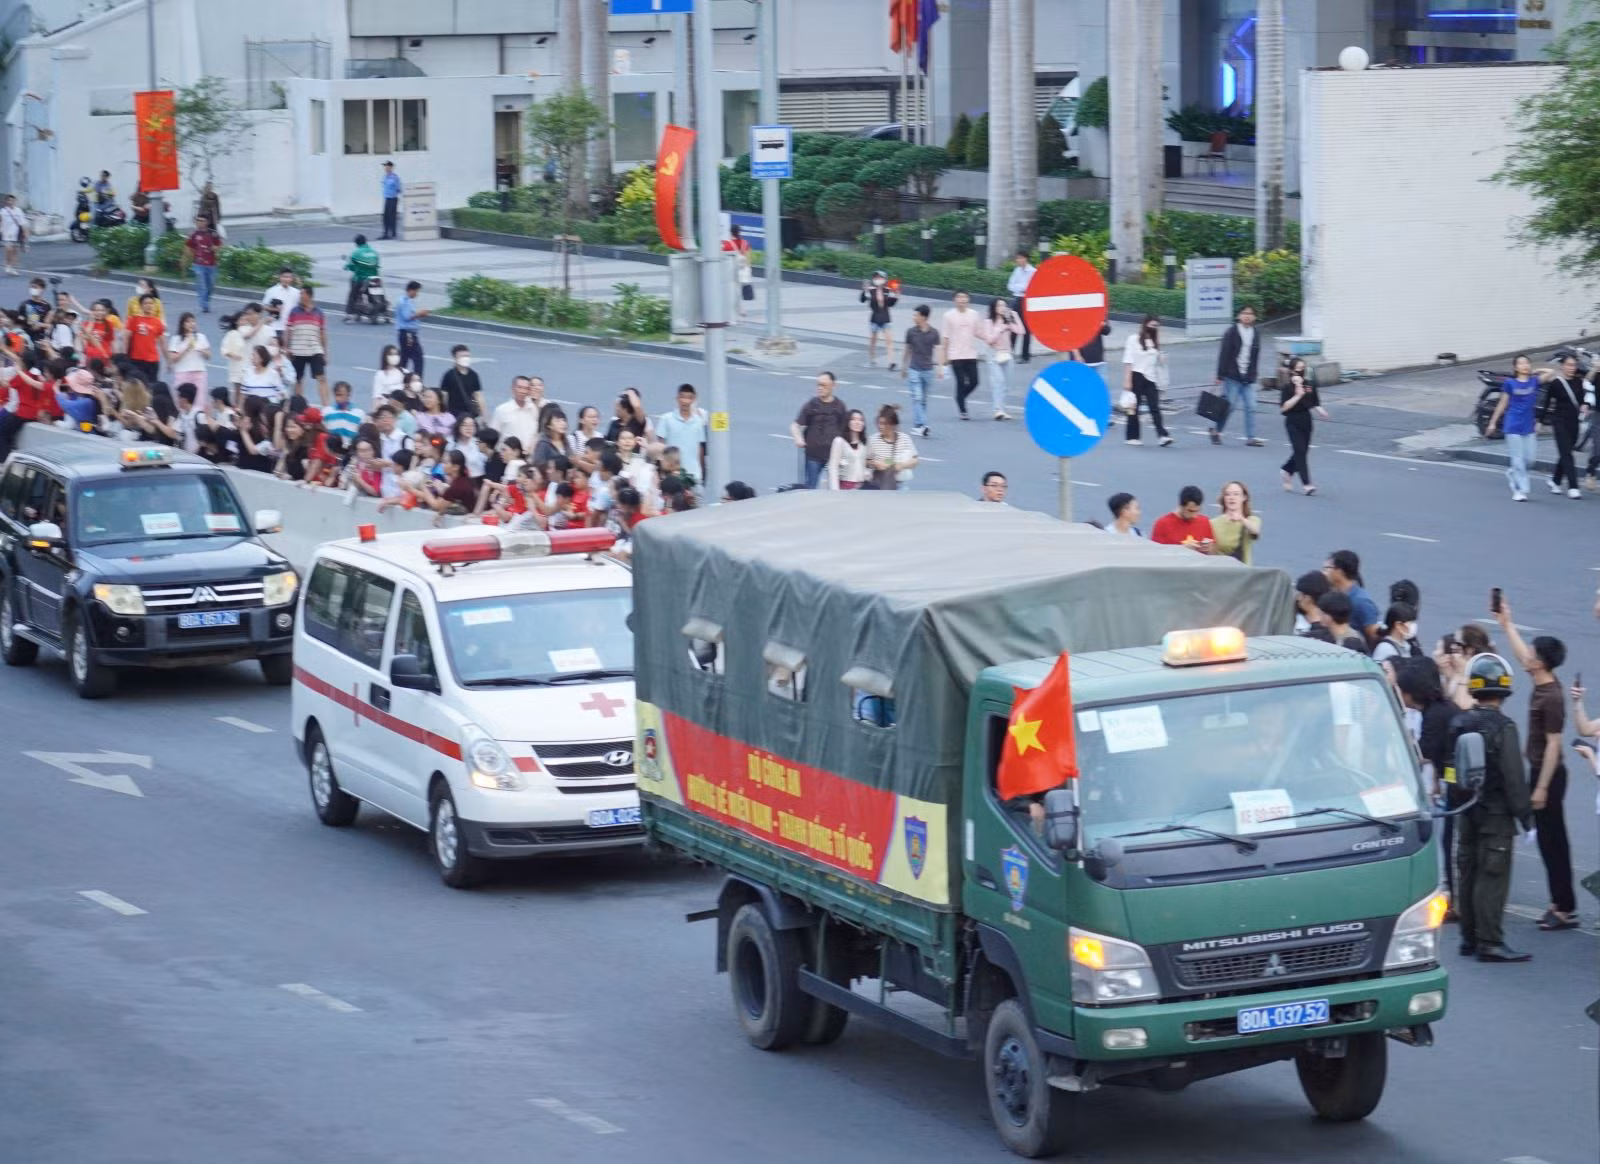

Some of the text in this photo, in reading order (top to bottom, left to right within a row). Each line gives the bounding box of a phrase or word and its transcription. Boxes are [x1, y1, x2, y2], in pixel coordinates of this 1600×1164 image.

[762, 754, 786, 792] CÔNG
[1352, 836, 1405, 851] CANTER
[1182, 921, 1365, 951] MITSUBISHI FUSO
[1239, 1002, 1326, 1031] 80A-037.52
